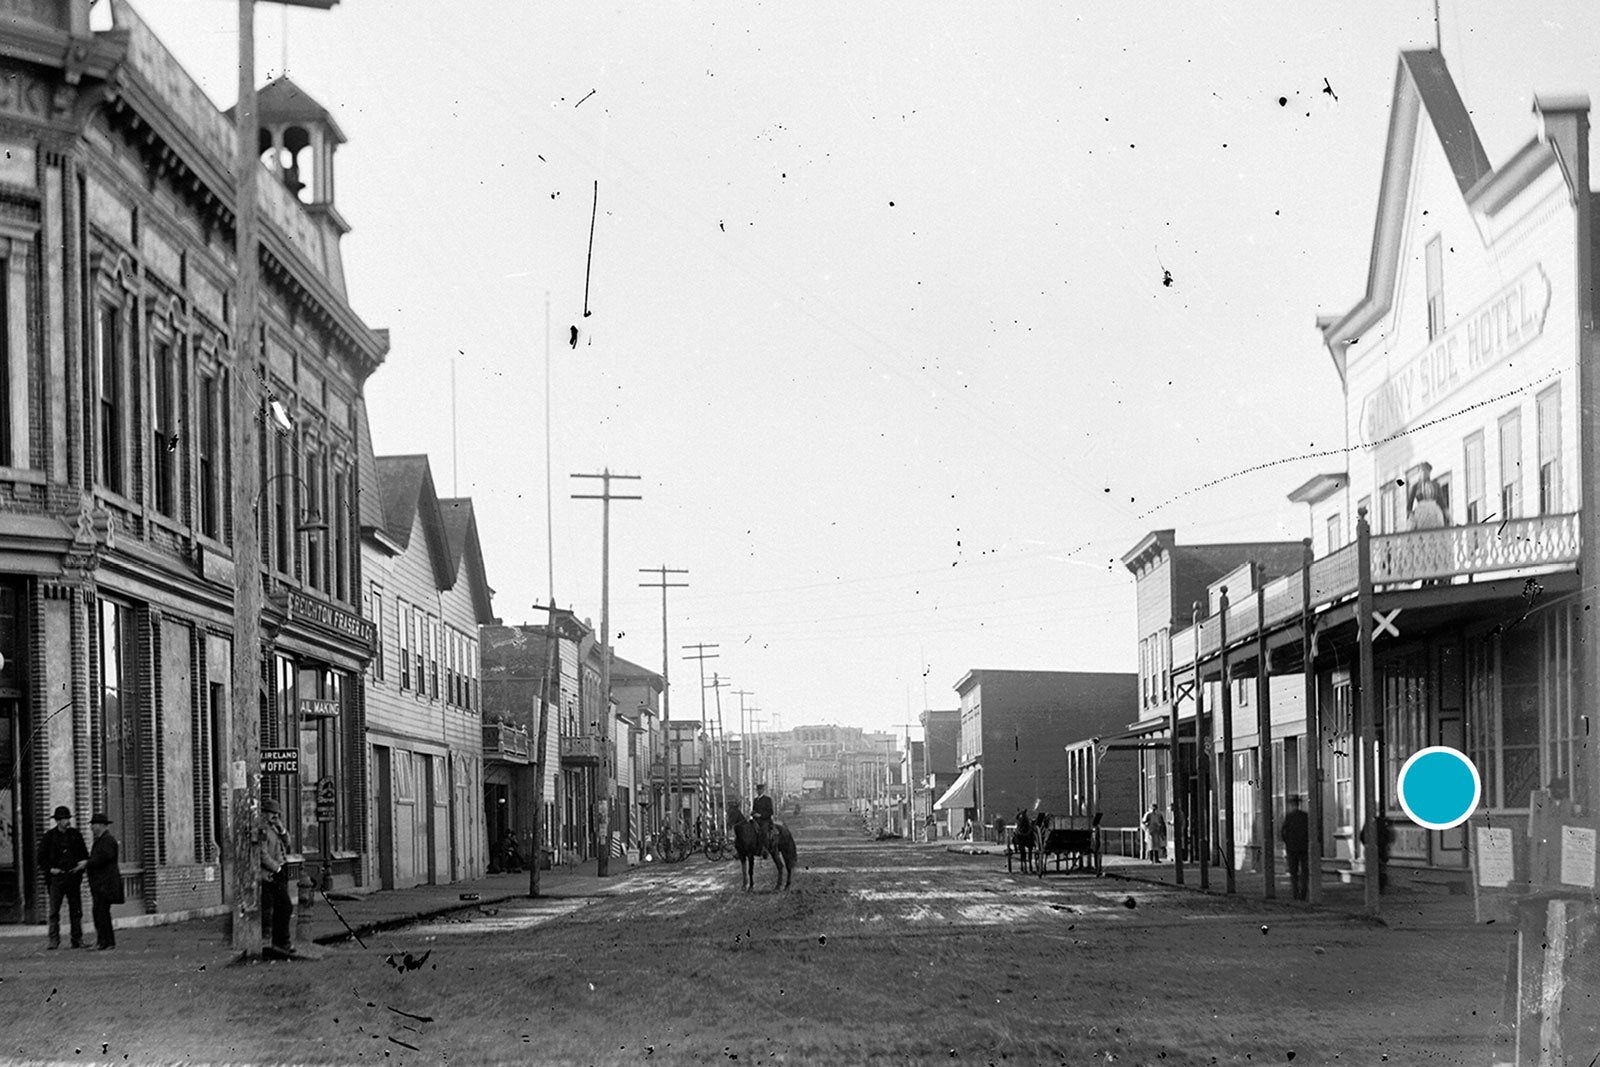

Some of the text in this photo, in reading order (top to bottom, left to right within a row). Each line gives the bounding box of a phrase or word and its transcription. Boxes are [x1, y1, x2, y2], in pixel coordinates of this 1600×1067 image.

[1419, 335, 1459, 402] SIDE
[334, 611, 360, 636] FRASER
[314, 701, 340, 715] MAKING
[267, 761, 297, 771] OFFICE
